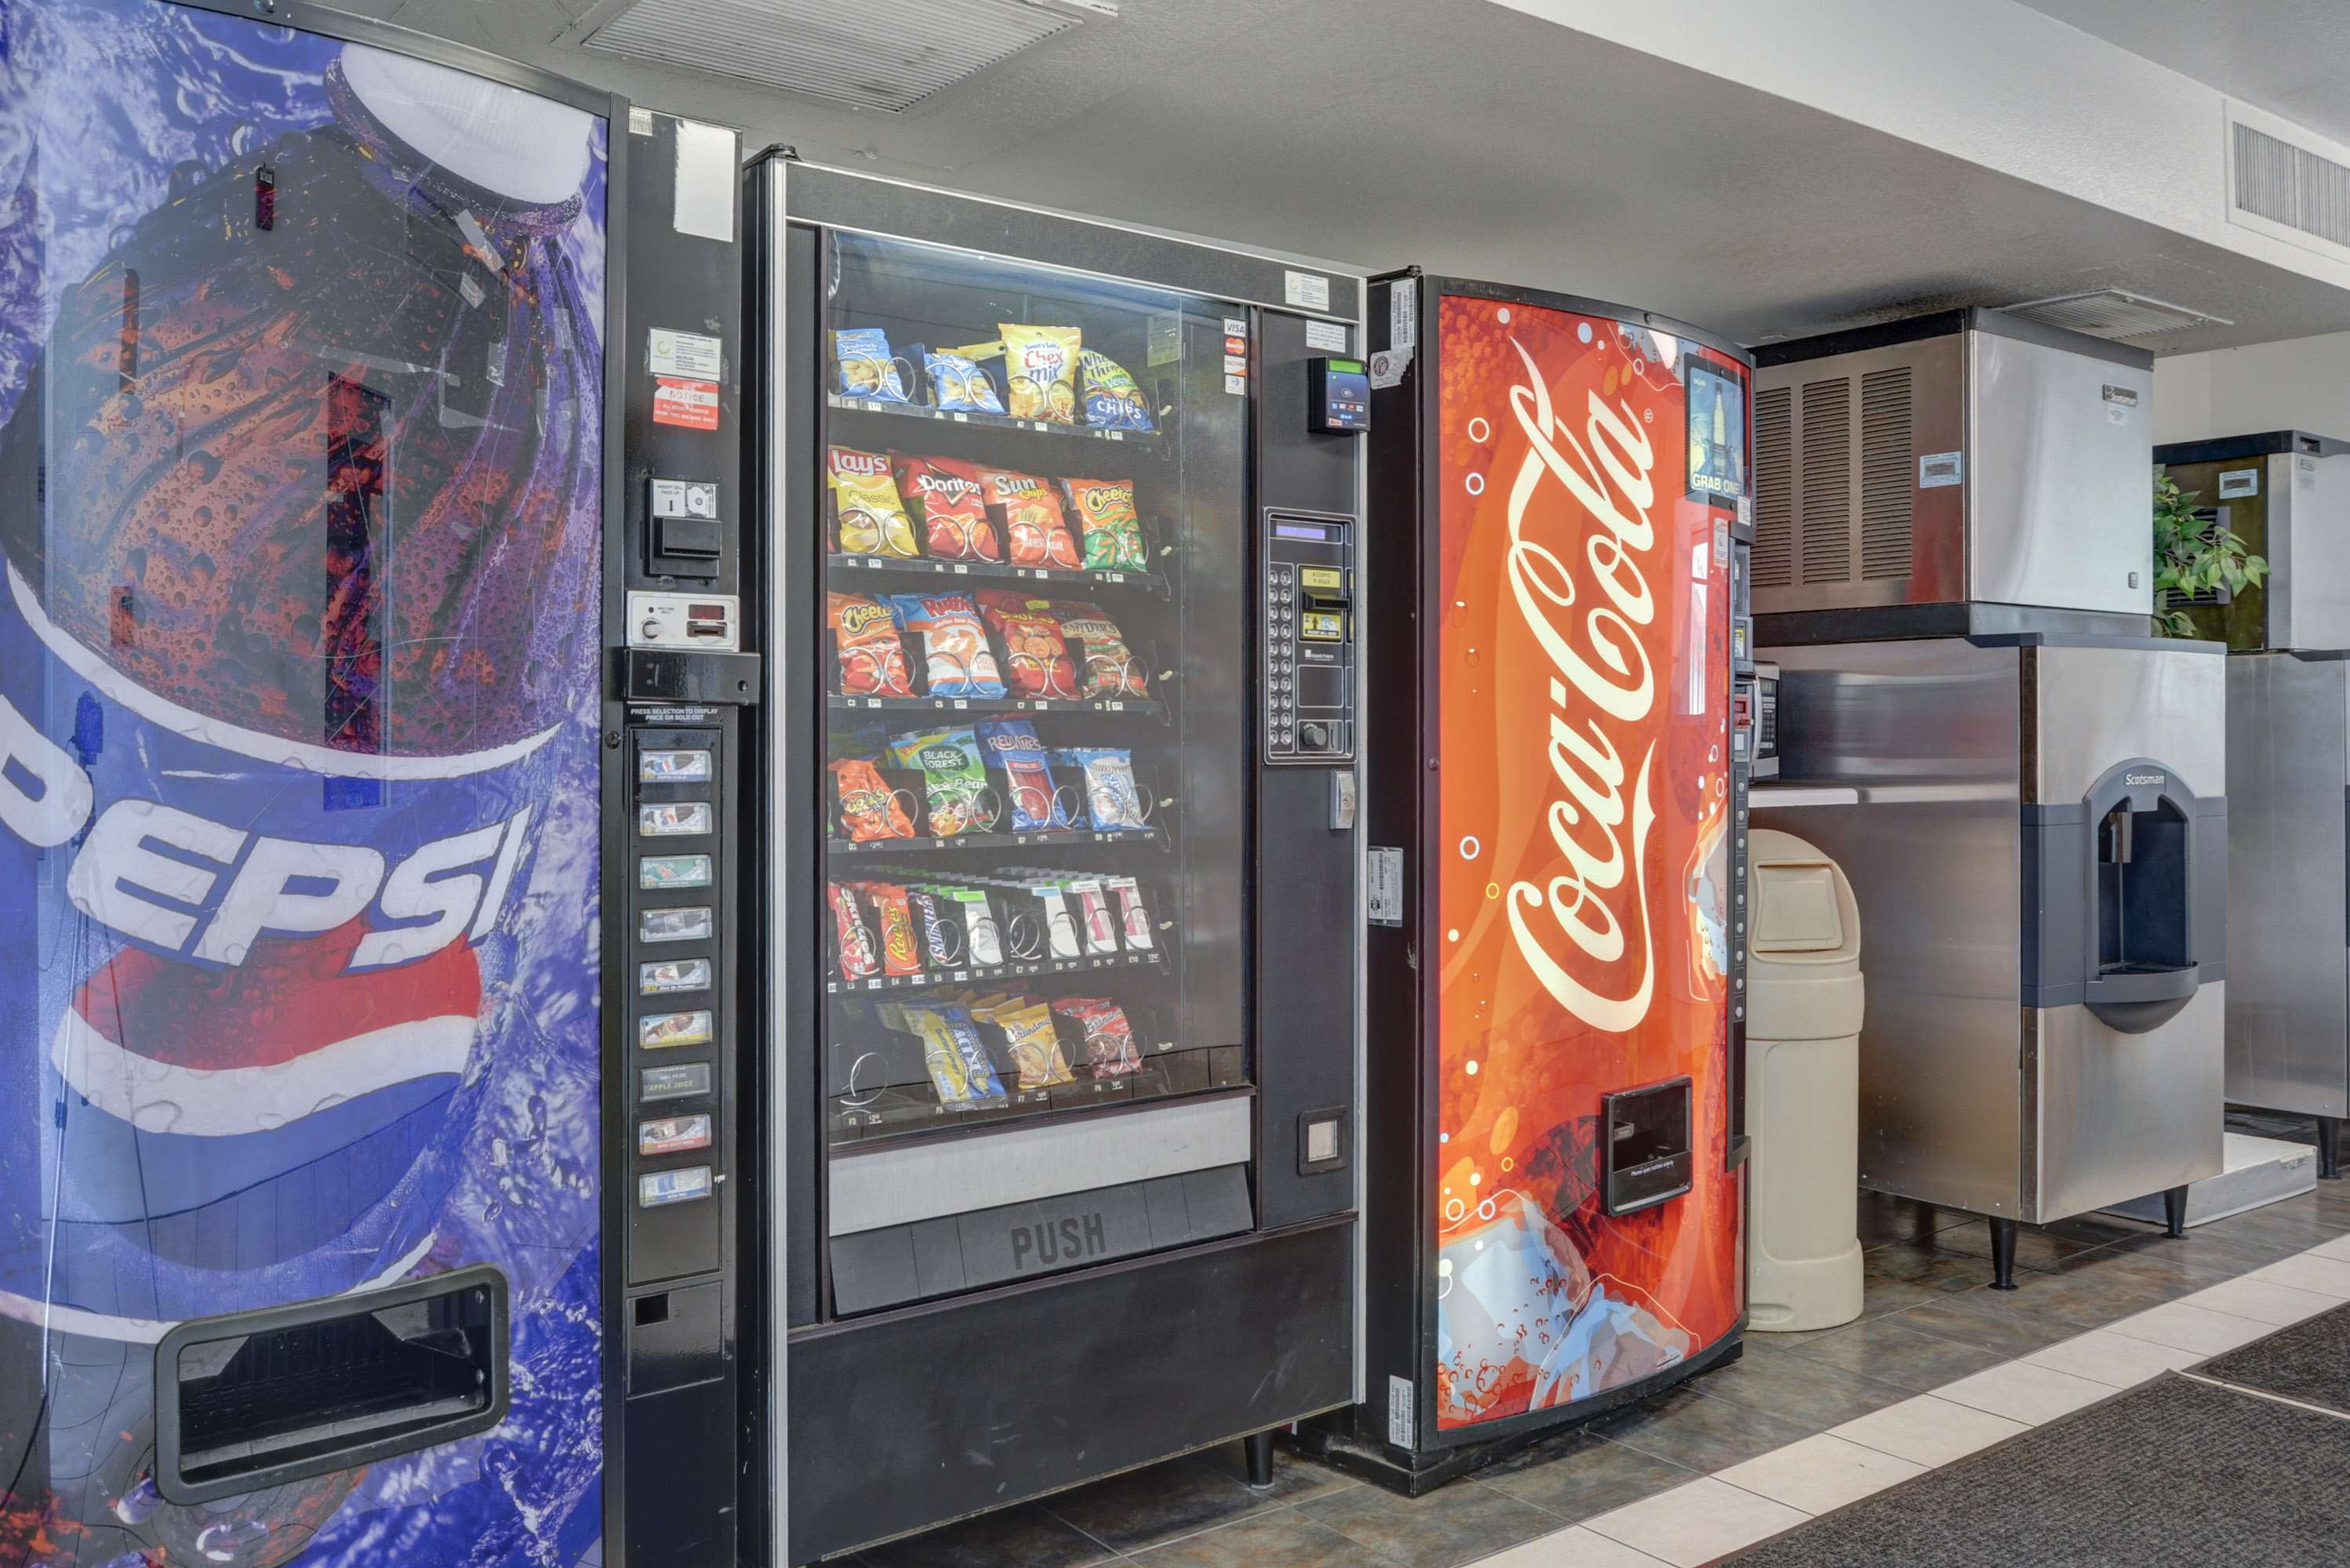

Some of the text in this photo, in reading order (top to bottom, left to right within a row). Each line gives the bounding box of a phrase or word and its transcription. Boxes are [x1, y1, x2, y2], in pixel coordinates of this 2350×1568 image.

[1226, 323, 1245, 333] VISA
[1024, 350, 1064, 369] Chex
[832, 449, 888, 477] Lay's
[993, 475, 1037, 495] Sun
[1692, 473, 1741, 494] GRAB ONE
[1019, 488, 1048, 501] Chips
[1507, 336, 1656, 1033] Coca-Cola
[923, 750, 957, 760] BLACK
[924, 758, 962, 768] FOREST
[2125, 774, 2165, 786] Scotsman
[648, 1082, 671, 1091] APPLE
[1010, 1213, 1106, 1270] PUSH
